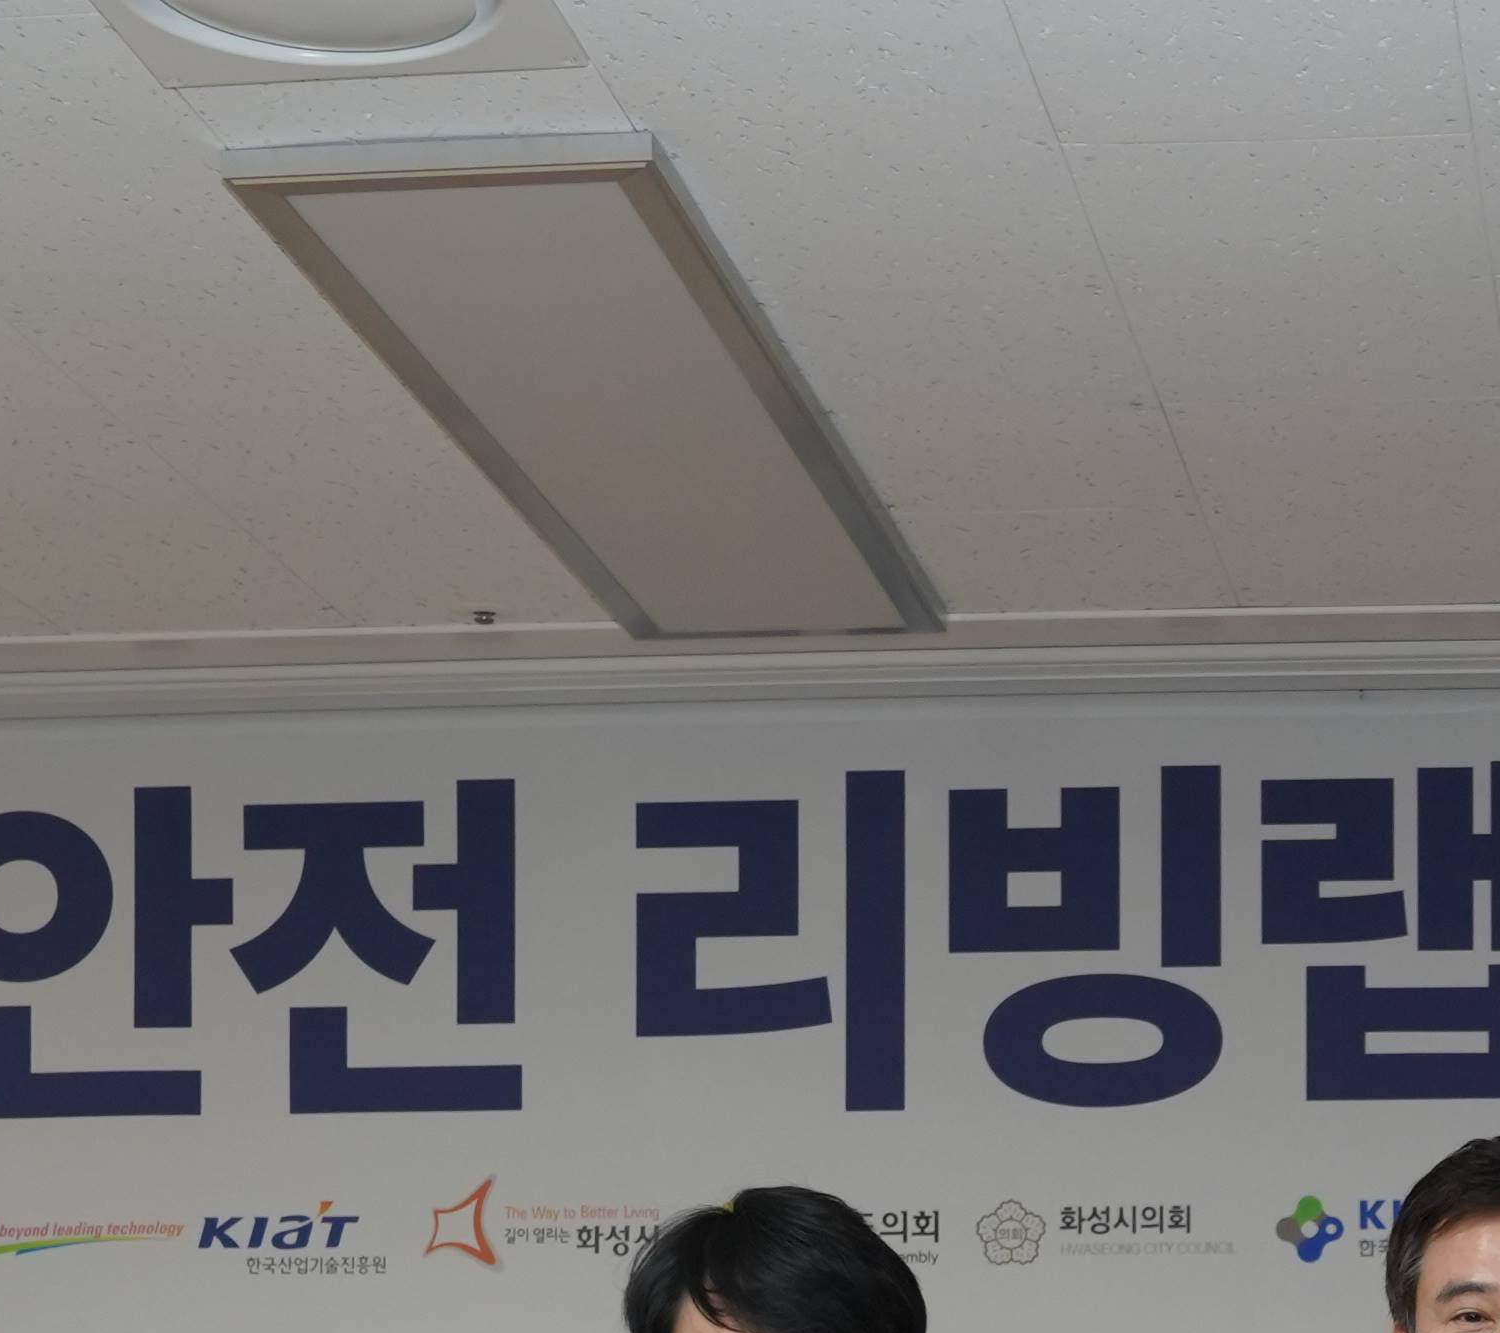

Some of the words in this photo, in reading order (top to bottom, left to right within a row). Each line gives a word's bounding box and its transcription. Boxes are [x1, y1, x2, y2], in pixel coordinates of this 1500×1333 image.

[505, 1205, 527, 1219] The
[531, 1205, 560, 1221] Way
[563, 1206, 576, 1219] to
[580, 1204, 619, 1219] Better
[623, 1204, 660, 1221] Living
[1059, 1204, 1193, 1235] 화성시의회
[53, 1221, 104, 1238] leading
[107, 1220, 185, 1238] technology
[504, 1227, 530, 1244] 길이
[533, 1227, 571, 1244] 열리는
[859, 1210, 939, 1243] 의회
[1059, 1242, 1141, 1256] HWASEONG
[1144, 1242, 1174, 1256] CITY
[1177, 1242, 1235, 1256] COUNCIL
[245, 1255, 388, 1275] 한국산업기술진흥원
